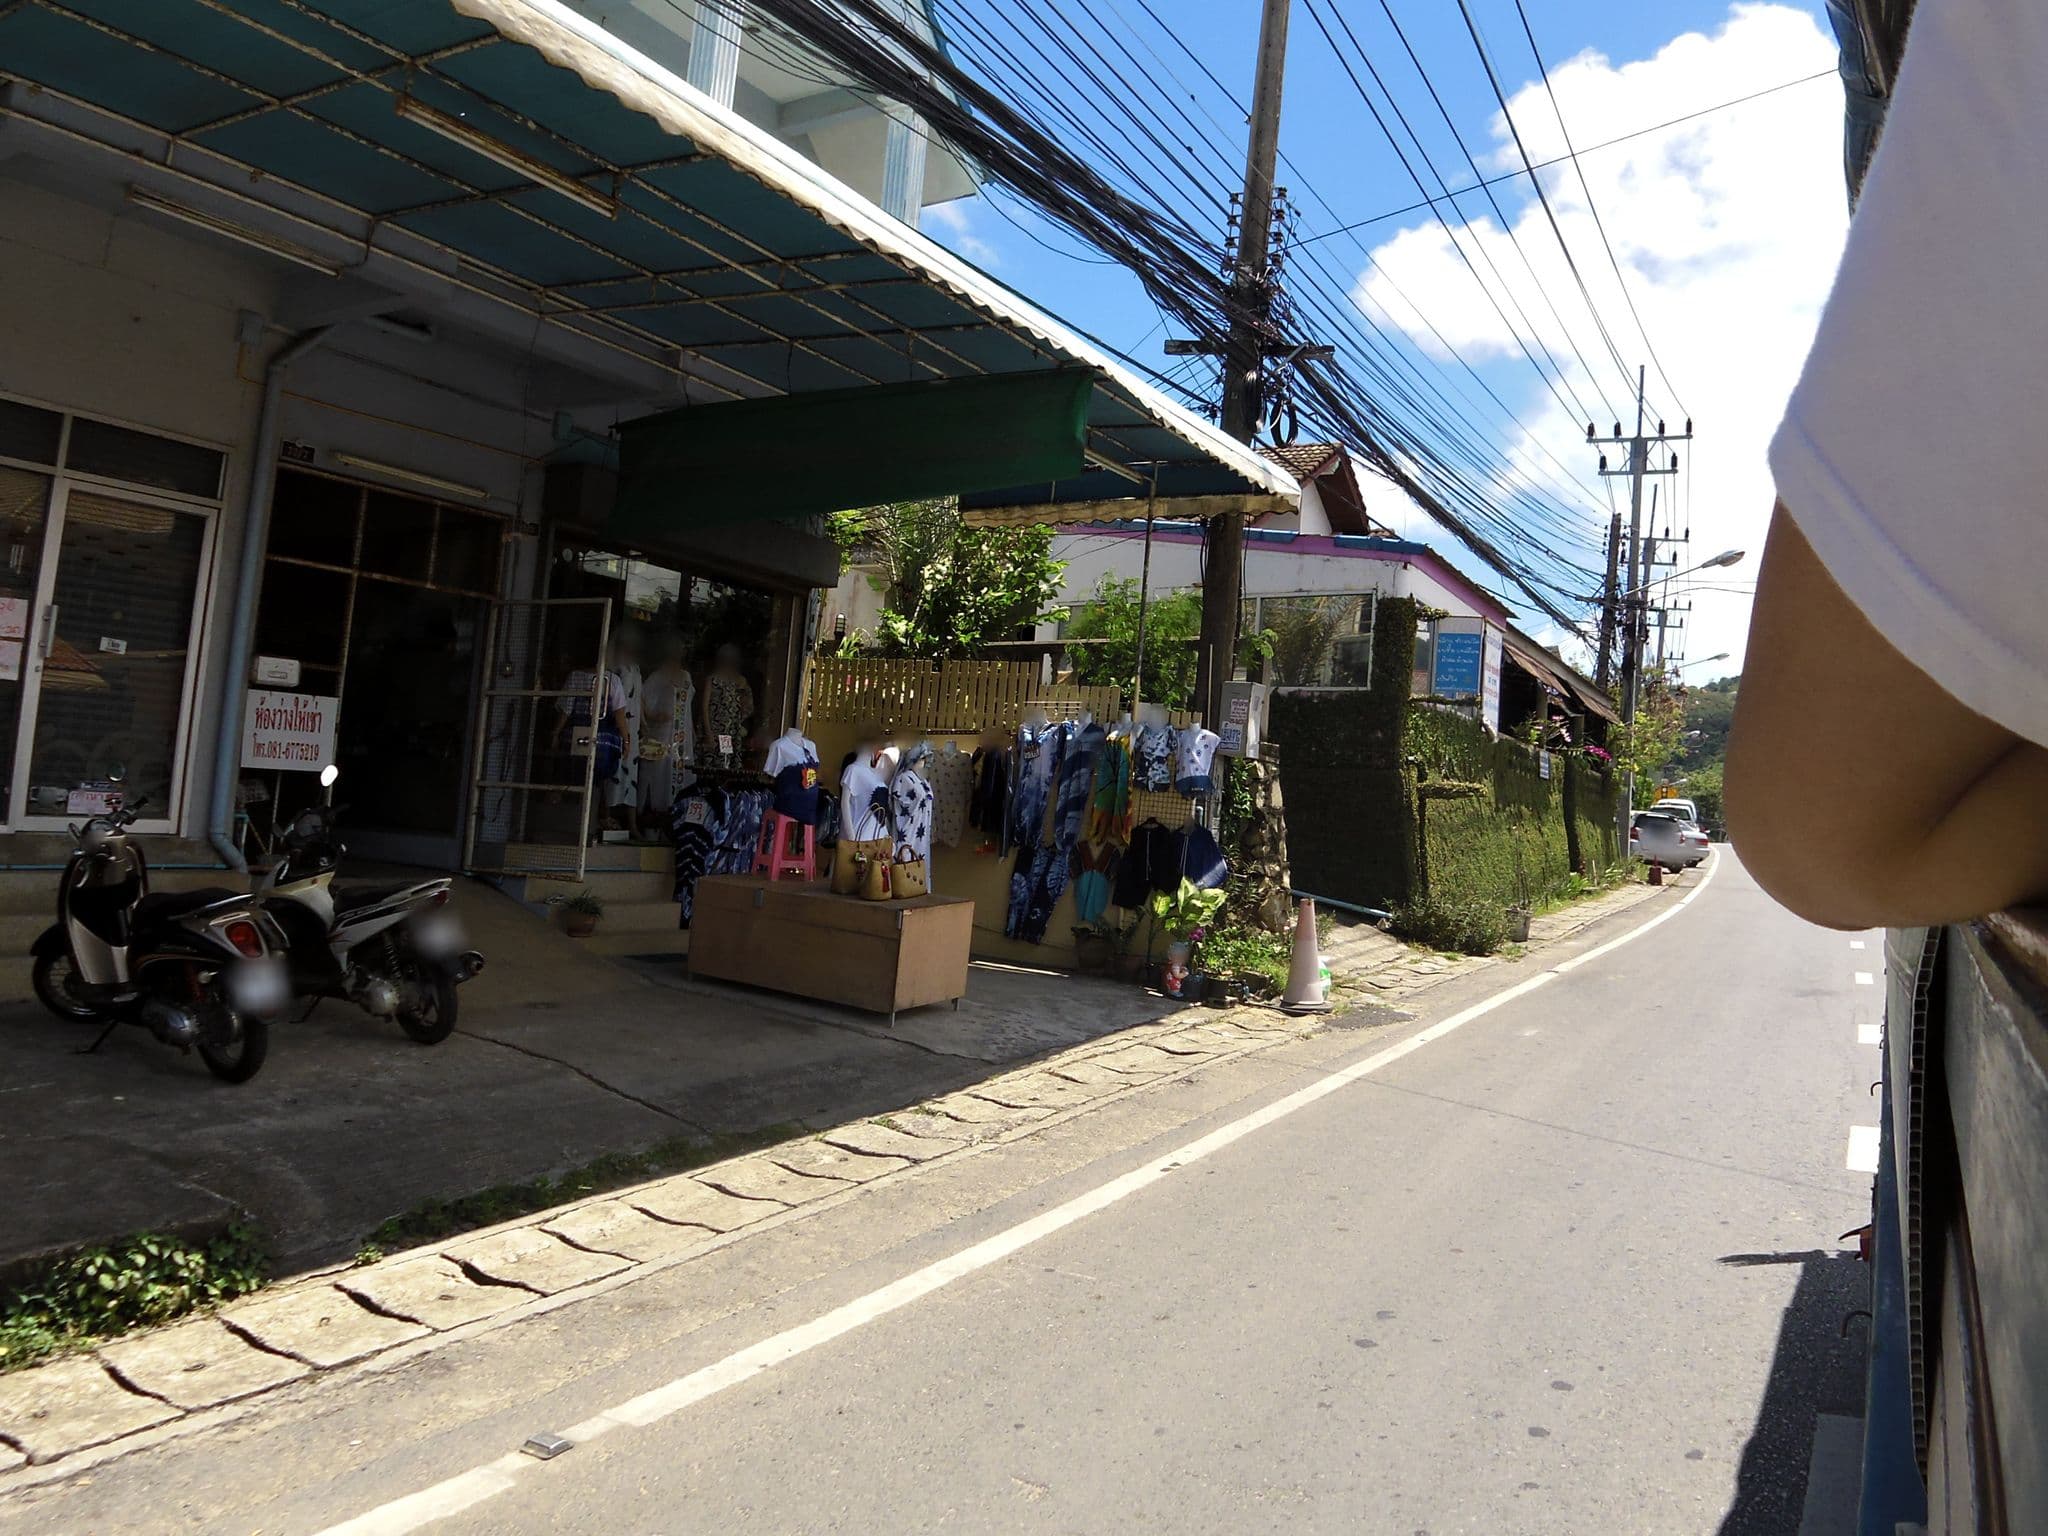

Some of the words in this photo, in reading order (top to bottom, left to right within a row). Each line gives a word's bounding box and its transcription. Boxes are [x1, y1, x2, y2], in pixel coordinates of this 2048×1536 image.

[256, 696, 322, 733] ห้องว่างให้เช่า
